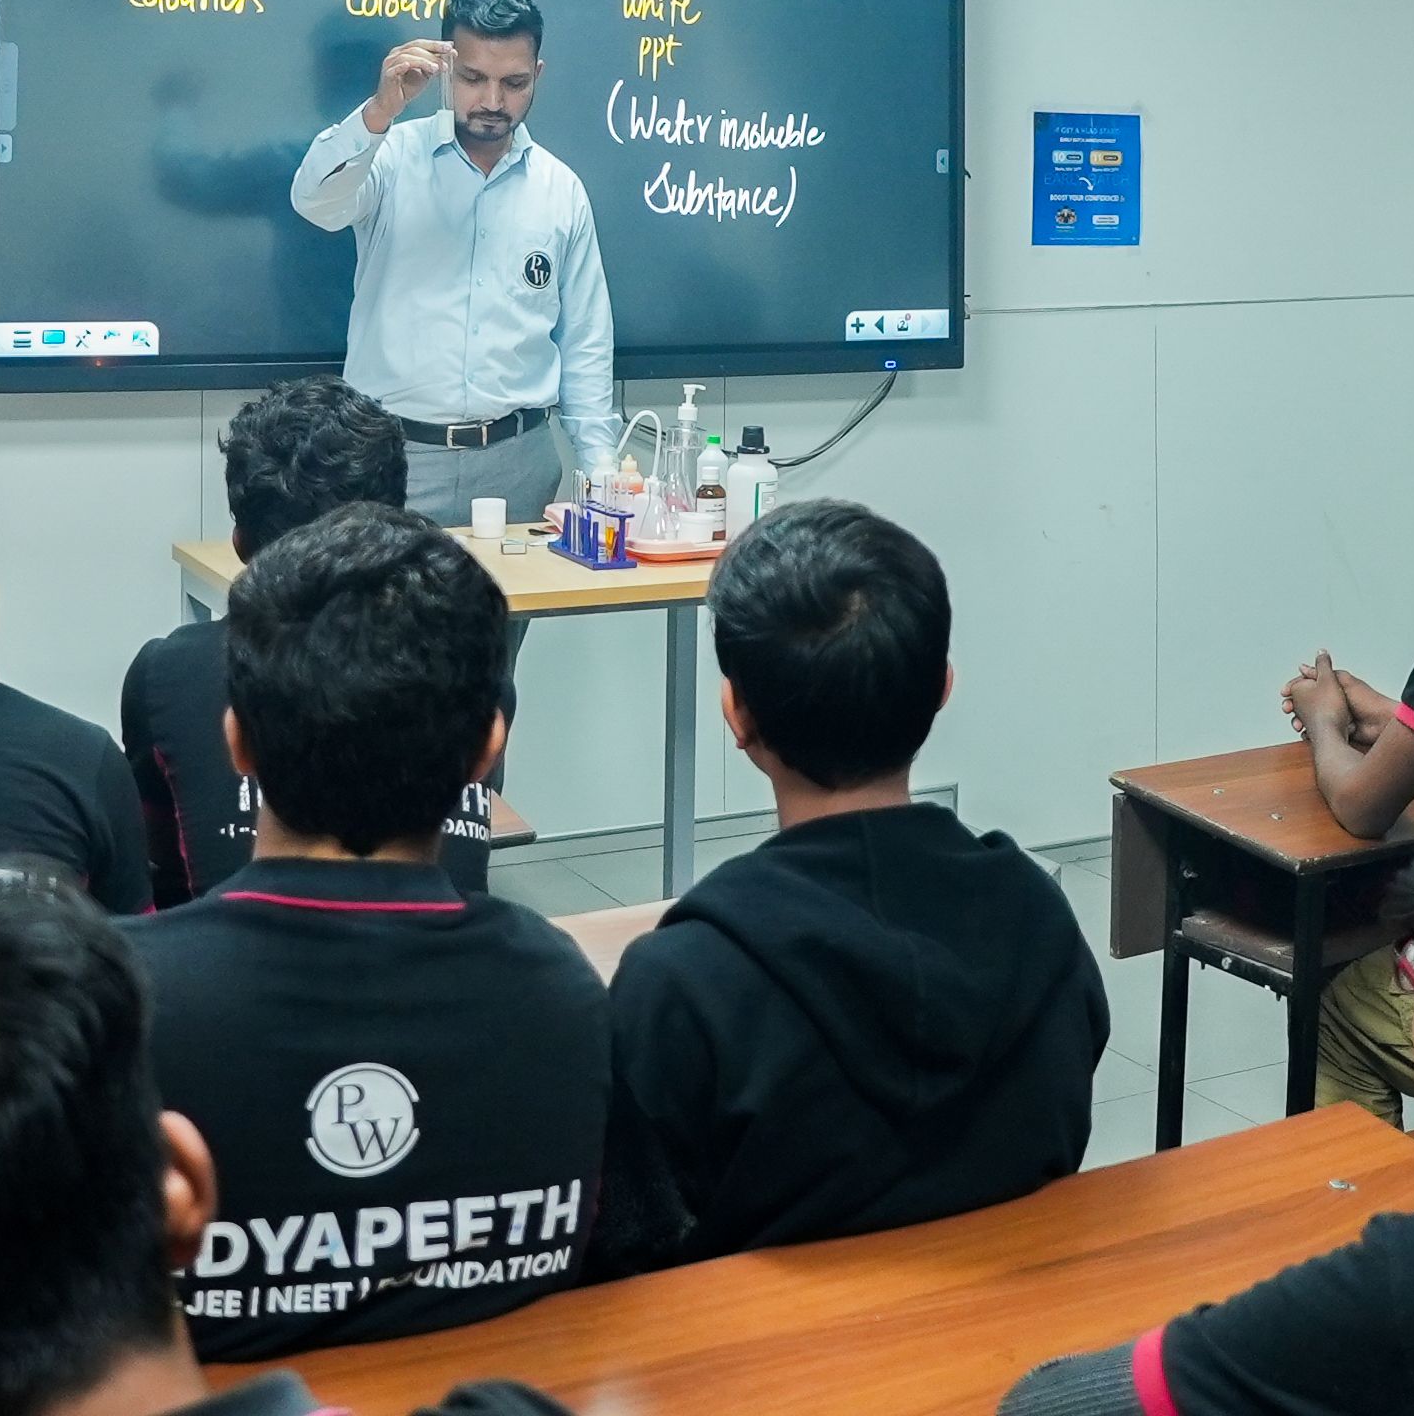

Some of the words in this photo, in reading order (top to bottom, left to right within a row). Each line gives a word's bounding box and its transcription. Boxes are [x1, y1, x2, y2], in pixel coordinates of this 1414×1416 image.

[638, 33, 683, 82] ppt
[193, 1178, 582, 1279] DYAPEETH
[265, 1281, 354, 1314] NEET
[379, 1245, 572, 1290] UNDATION
